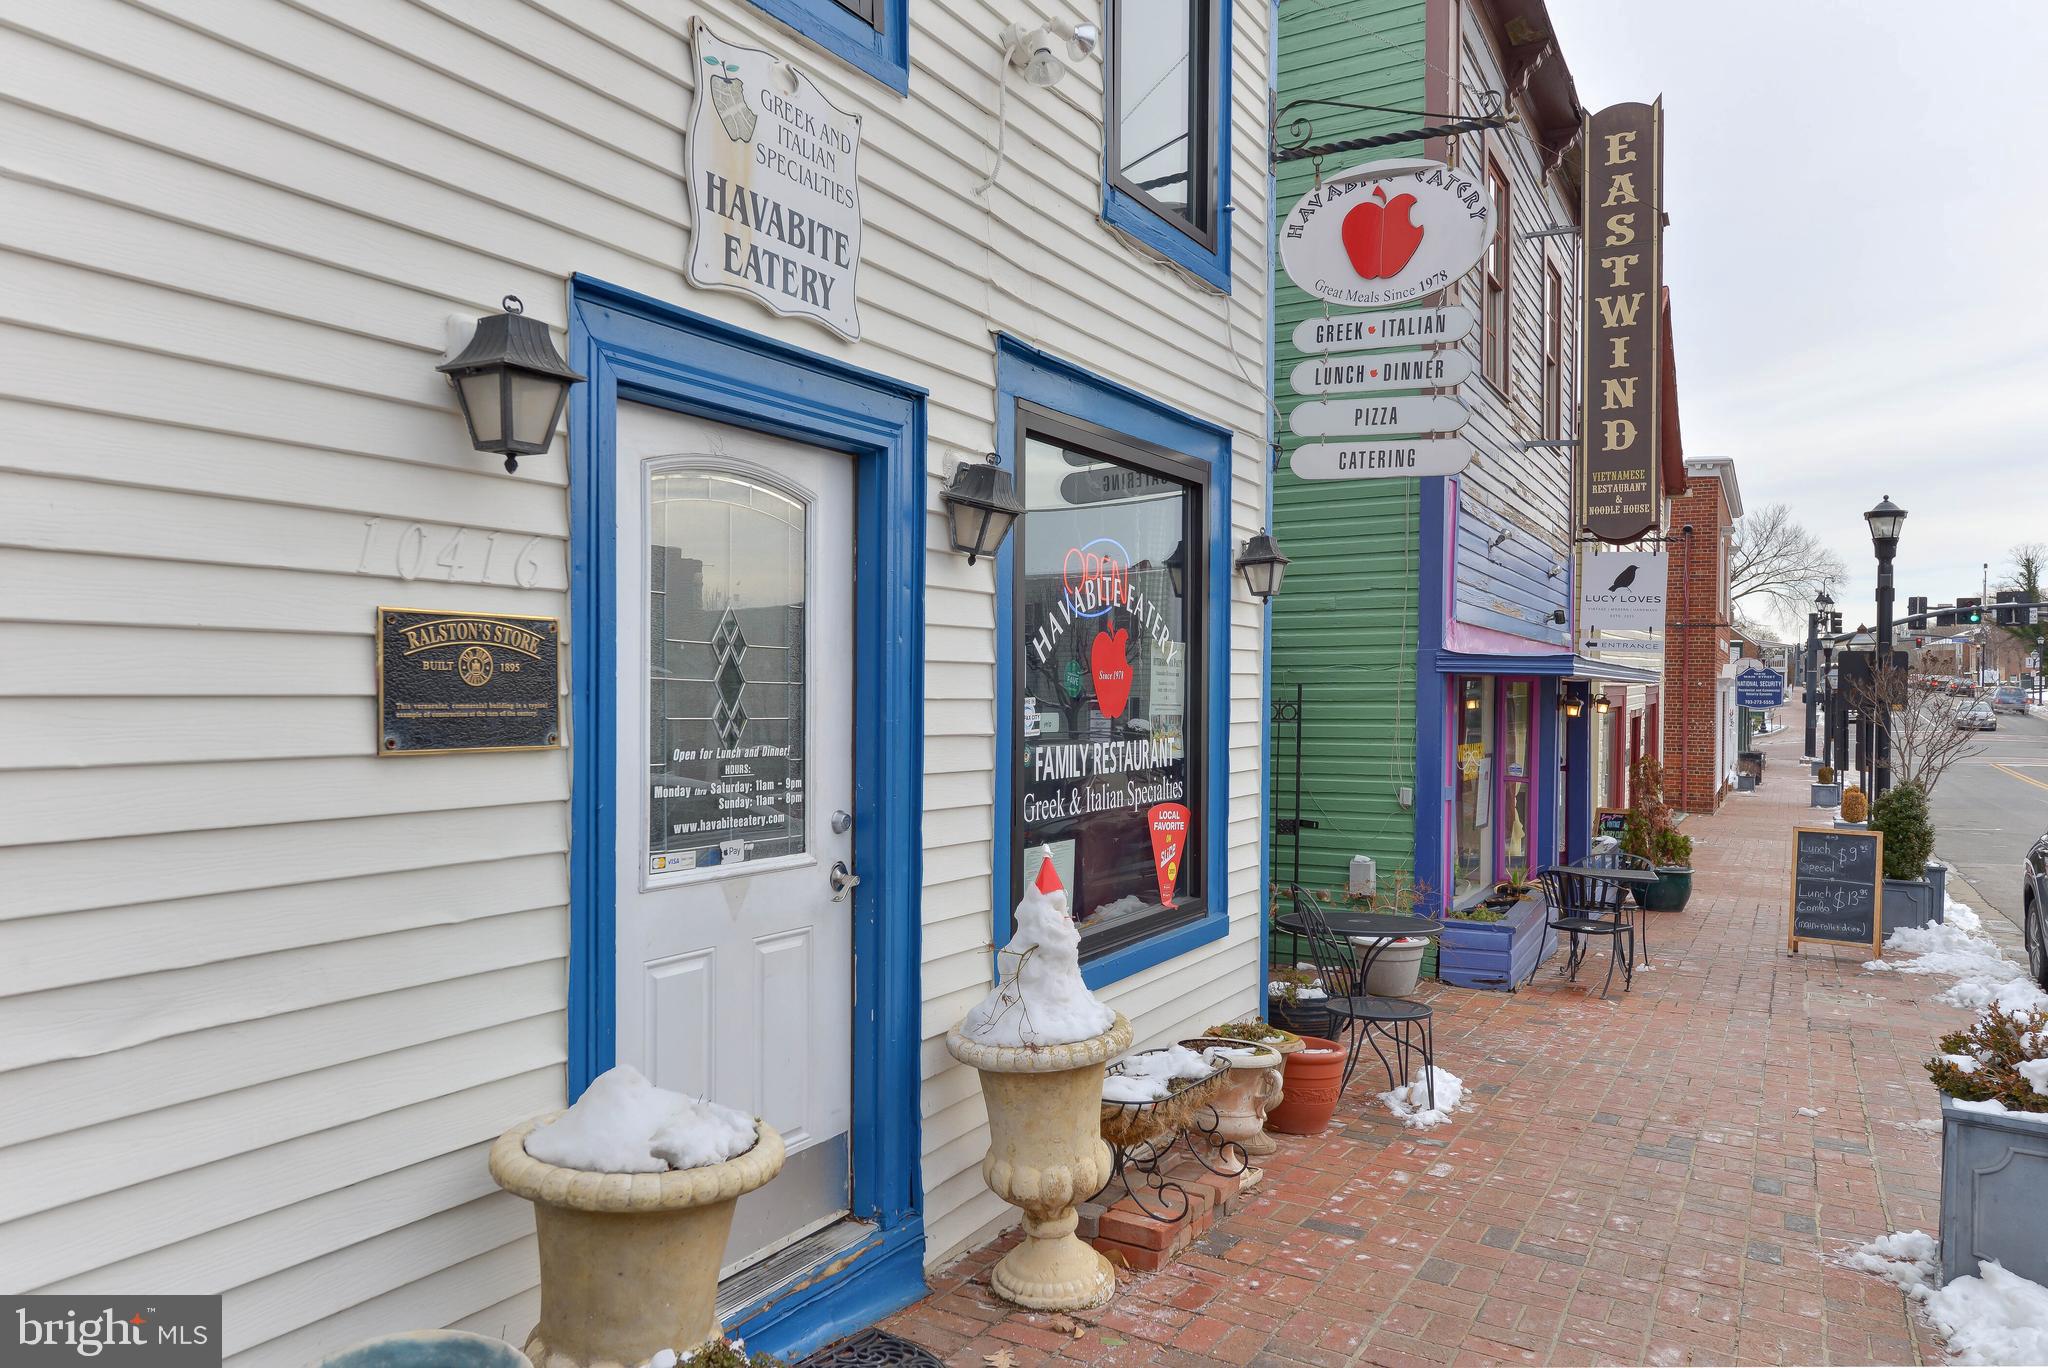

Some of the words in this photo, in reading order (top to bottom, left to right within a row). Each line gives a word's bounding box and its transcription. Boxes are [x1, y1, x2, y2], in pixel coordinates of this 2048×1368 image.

[760, 89, 816, 136] GREEK
[819, 123, 851, 154] AND
[777, 124, 836, 172] ITALIAN
[755, 142, 854, 209] SPECIALTIES
[705, 170, 850, 270] HAVABITE
[723, 232, 835, 311] EATERY
[1314, 278, 1343, 299] Great
[1346, 290, 1380, 303] Meals
[1383, 286, 1416, 301] Since
[1418, 269, 1448, 292] 1978
[1595, 130, 1645, 453] EASTWIND
[1316, 322, 1363, 343] GREEK
[1381, 314, 1446, 338] ITALIAN
[1315, 365, 1365, 386] LUNCH
[1383, 360, 1444, 382] DINNER
[1354, 406, 1398, 426] PIZZA
[1338, 448, 1416, 470] CATERING
[1592, 469, 1645, 482] VIETNAMESE
[1592, 482, 1647, 494] RESTAURANT
[1589, 505, 1621, 516] NOODLE
[1622, 503, 1650, 514] HOUSE
[1615, 495, 1623, 504] &
[357, 516, 543, 588] 10416
[1064, 548, 1129, 604] OPEN
[1585, 594, 1617, 603] LUCY
[1620, 594, 1662, 604] LOVES
[1032, 577, 1120, 664] HAVABITE
[1126, 583, 1178, 665] EATERY
[406, 622, 491, 650] RALSTON'S
[494, 626, 540, 654] STORE
[1601, 642, 1660, 650] ENTRANCE
[423, 661, 454, 671] BUILT
[500, 663, 520, 672] 1895
[1099, 670, 1111, 680] Since
[673, 748, 695, 762] Open
[699, 748, 713, 760] for
[716, 747, 741, 759] Lunch
[744, 746, 759, 758] and
[762, 745, 791, 757] Dinner!
[1034, 743, 1089, 782] FAMILY
[1093, 737, 1175, 776] RESTAURANT
[725, 764, 751, 775] HOURS:
[654, 785, 691, 799] Monday
[694, 788, 707, 796] thru
[710, 781, 752, 795] Saturday:
[756, 779, 774, 791] 11am
[786, 777, 802, 790] 9pm
[718, 797, 752, 810] Sunday:
[756, 795, 774, 806] 11am
[786, 793, 802, 805] 8pm
[1023, 788, 1065, 823] Greek
[1070, 787, 1082, 815] &
[1085, 784, 1124, 814] Italian
[1127, 777, 1183, 813] Specialties
[673, 813, 785, 834] www.havabiteeatery.com
[1159, 810, 1180, 820] LOCAL
[1154, 821, 1184, 831] FAVORITE
[729, 847, 741, 856] Pay
[1800, 840, 1831, 854] Lunch
[1800, 856, 1835, 874] Special
[1799, 884, 1831, 899] Lunch
[1796, 901, 1831, 913] Combo
